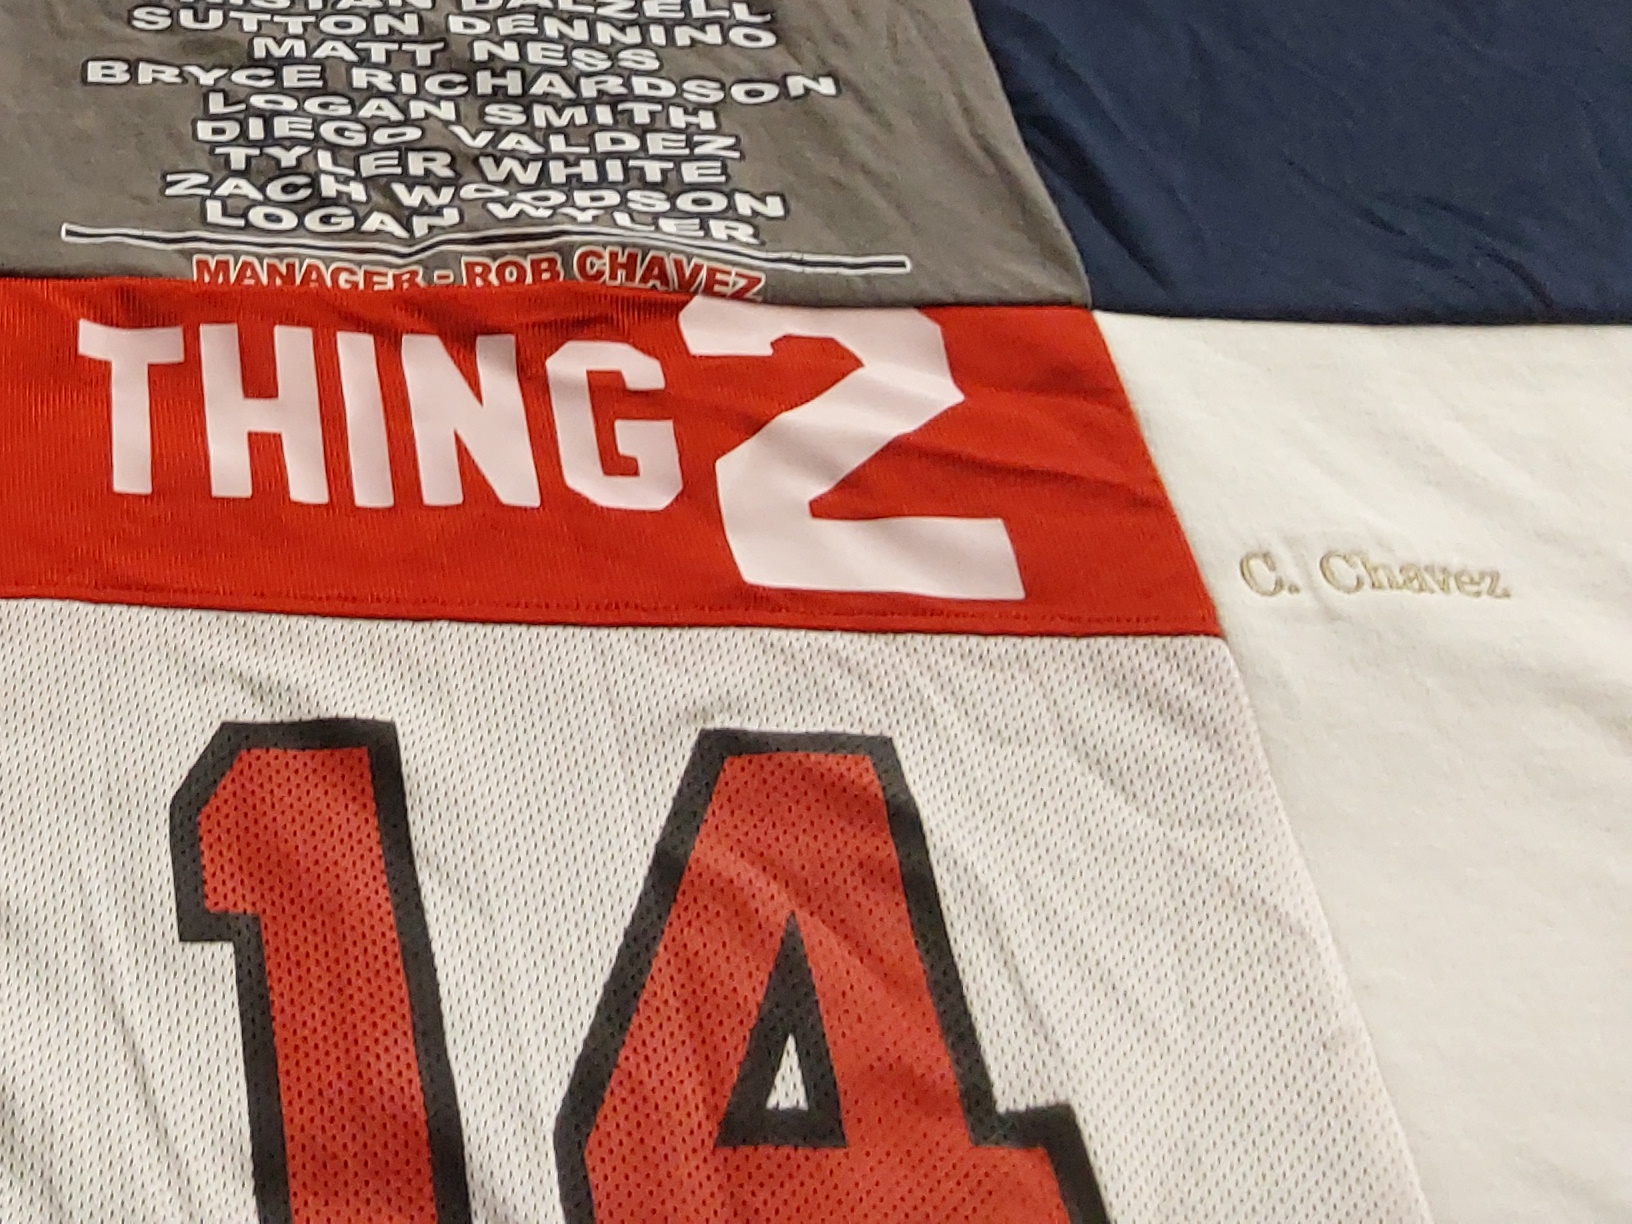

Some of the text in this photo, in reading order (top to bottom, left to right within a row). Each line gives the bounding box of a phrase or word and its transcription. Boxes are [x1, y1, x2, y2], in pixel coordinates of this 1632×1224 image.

[129, 5, 779, 49] SUTTON DENNINO
[252, 35, 662, 72] MATT NESS
[85, 59, 840, 105] BRYCE RICHARDSON
[207, 90, 718, 131] LOGAN SMITH
[195, 116, 742, 160] DIEGO VALDEZ
[213, 145, 728, 185] TYLER WHITE
[164, 173, 787, 220] ZACH WOODSON
[204, 199, 764, 246] LOGAN WYLER
[191, 252, 423, 293] MANAGER
[460, 252, 566, 288] ROB
[570, 244, 767, 303] CHAVEZ
[77, 296, 1027, 602] THING 2
[1238, 547, 1514, 600] C. Chavez
[169, 716, 1116, 1224] 14
